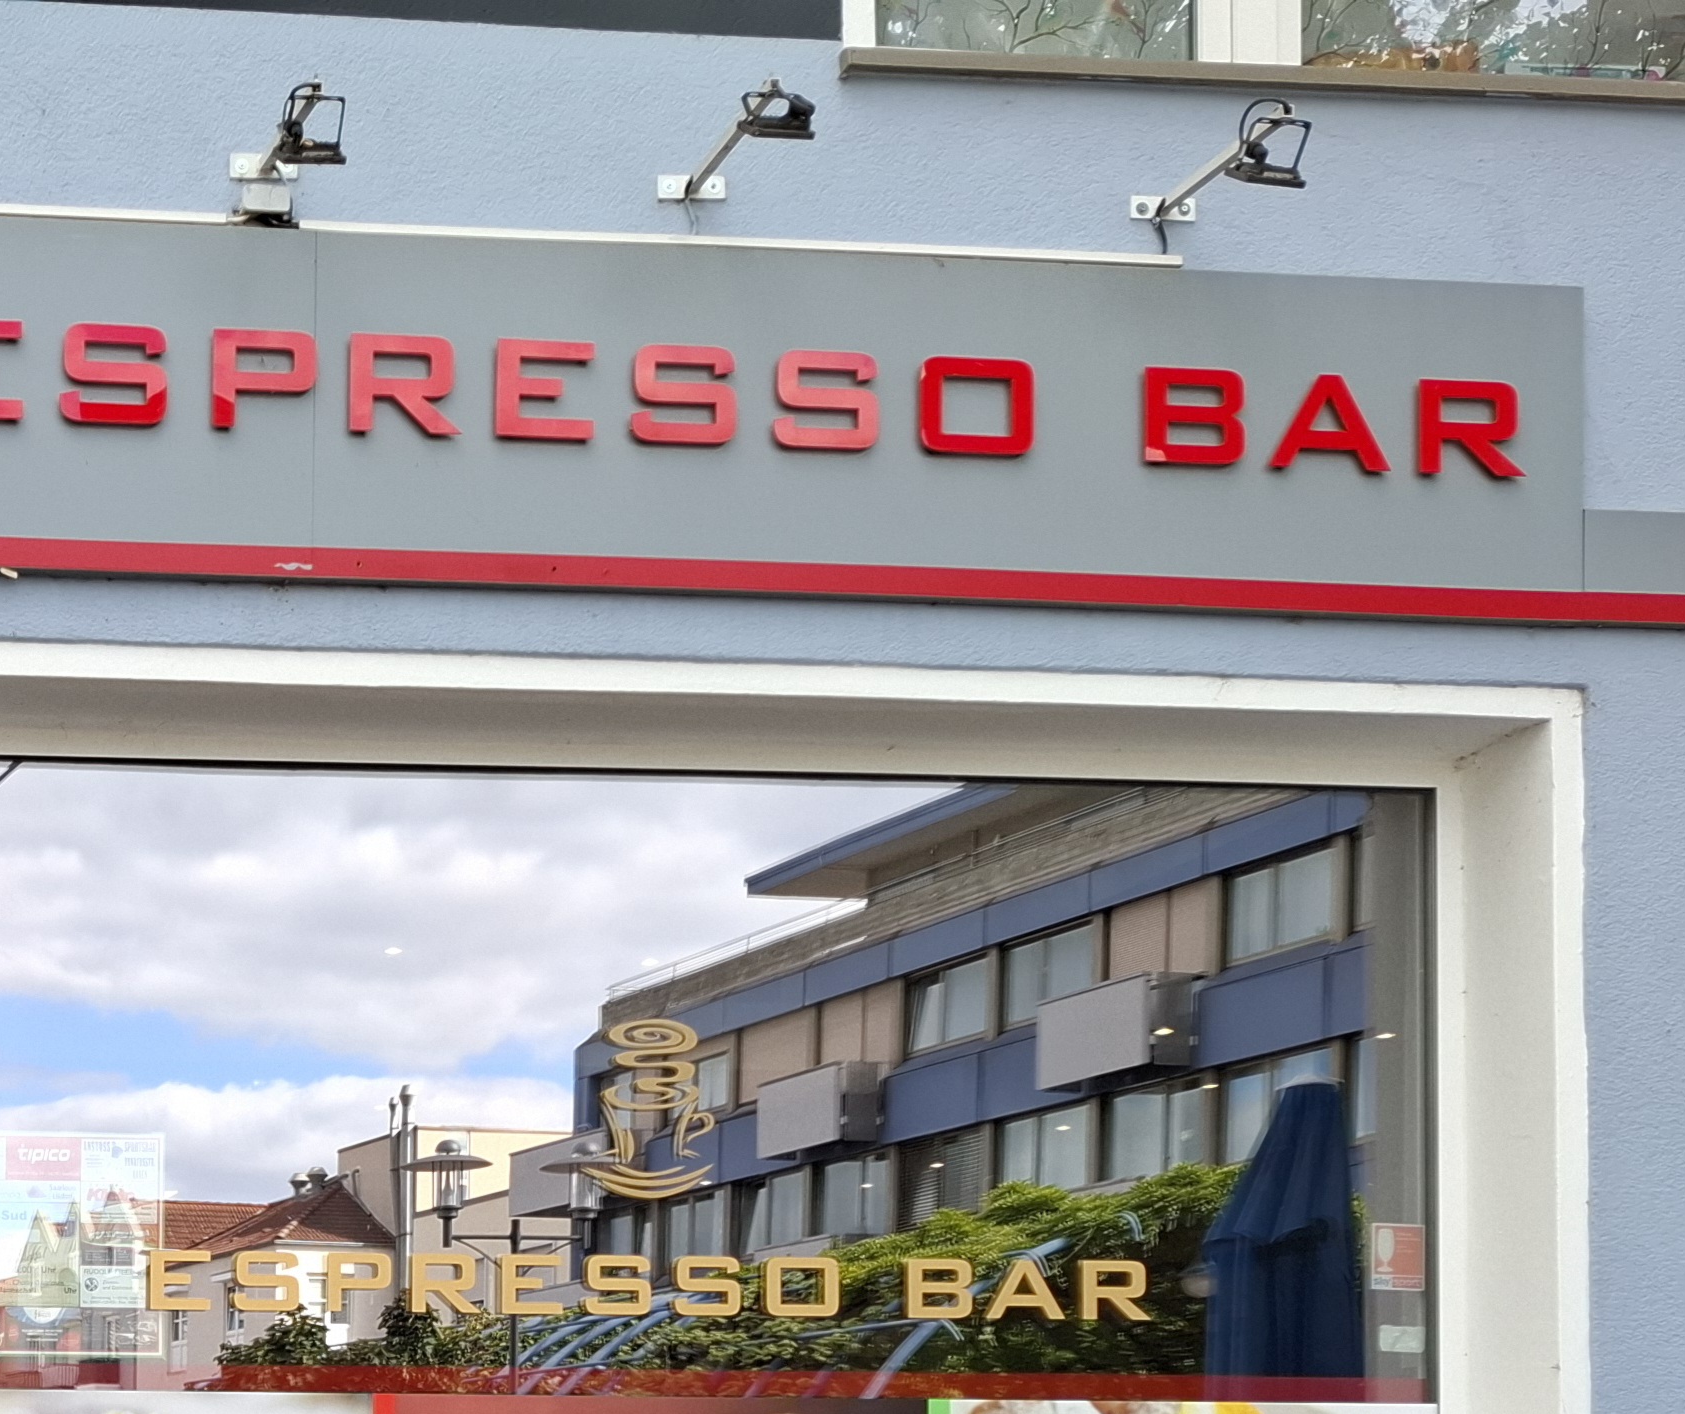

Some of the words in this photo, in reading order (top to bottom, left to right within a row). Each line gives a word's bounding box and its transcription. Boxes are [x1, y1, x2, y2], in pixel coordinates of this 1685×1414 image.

[1143, 366, 1528, 478] BAR
[17, 1143, 71, 1164] tipico
[1, 1209, 27, 1221] Sud
[146, 1249, 842, 1318] ESPRESSO
[903, 1258, 1150, 1322] BAR
